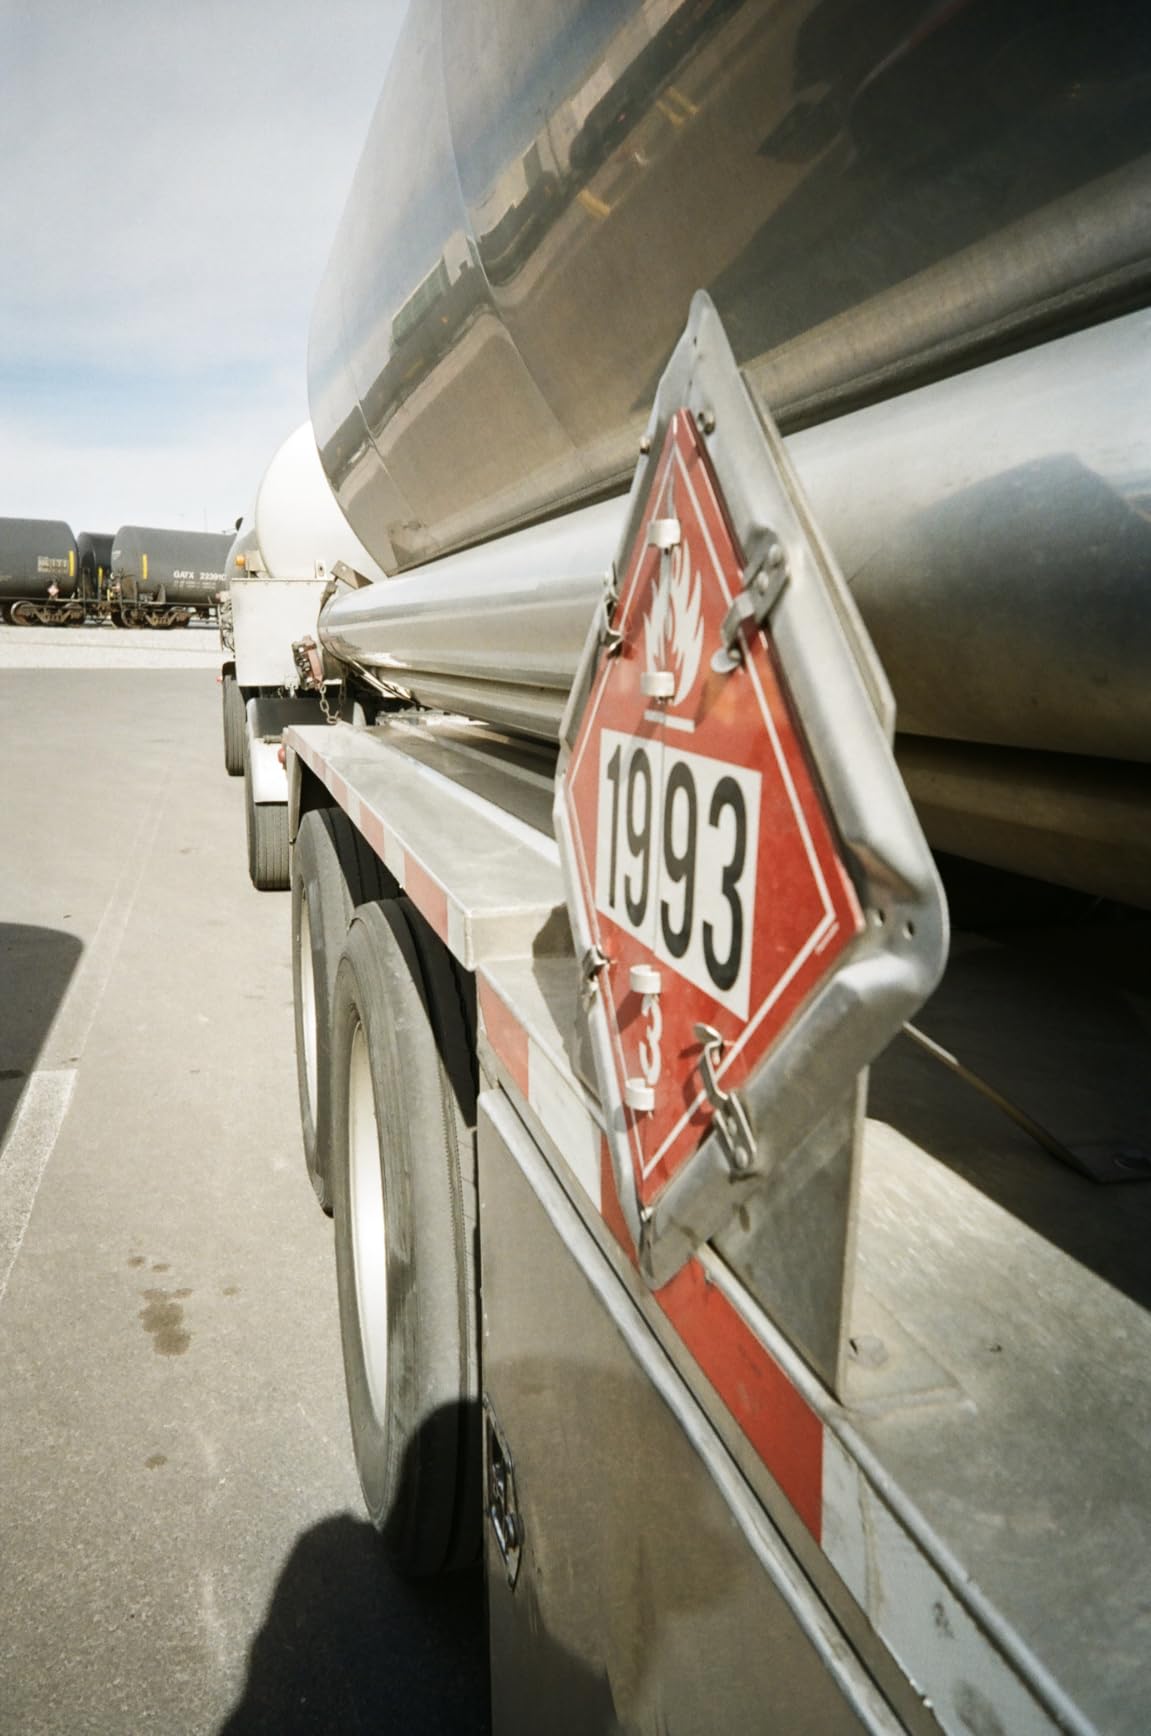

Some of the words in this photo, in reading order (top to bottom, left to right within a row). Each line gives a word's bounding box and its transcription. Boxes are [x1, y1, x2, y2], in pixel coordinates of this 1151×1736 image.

[173, 570, 194, 580] GATX
[607, 744, 747, 991] 1993
[639, 994, 663, 1085] 3
